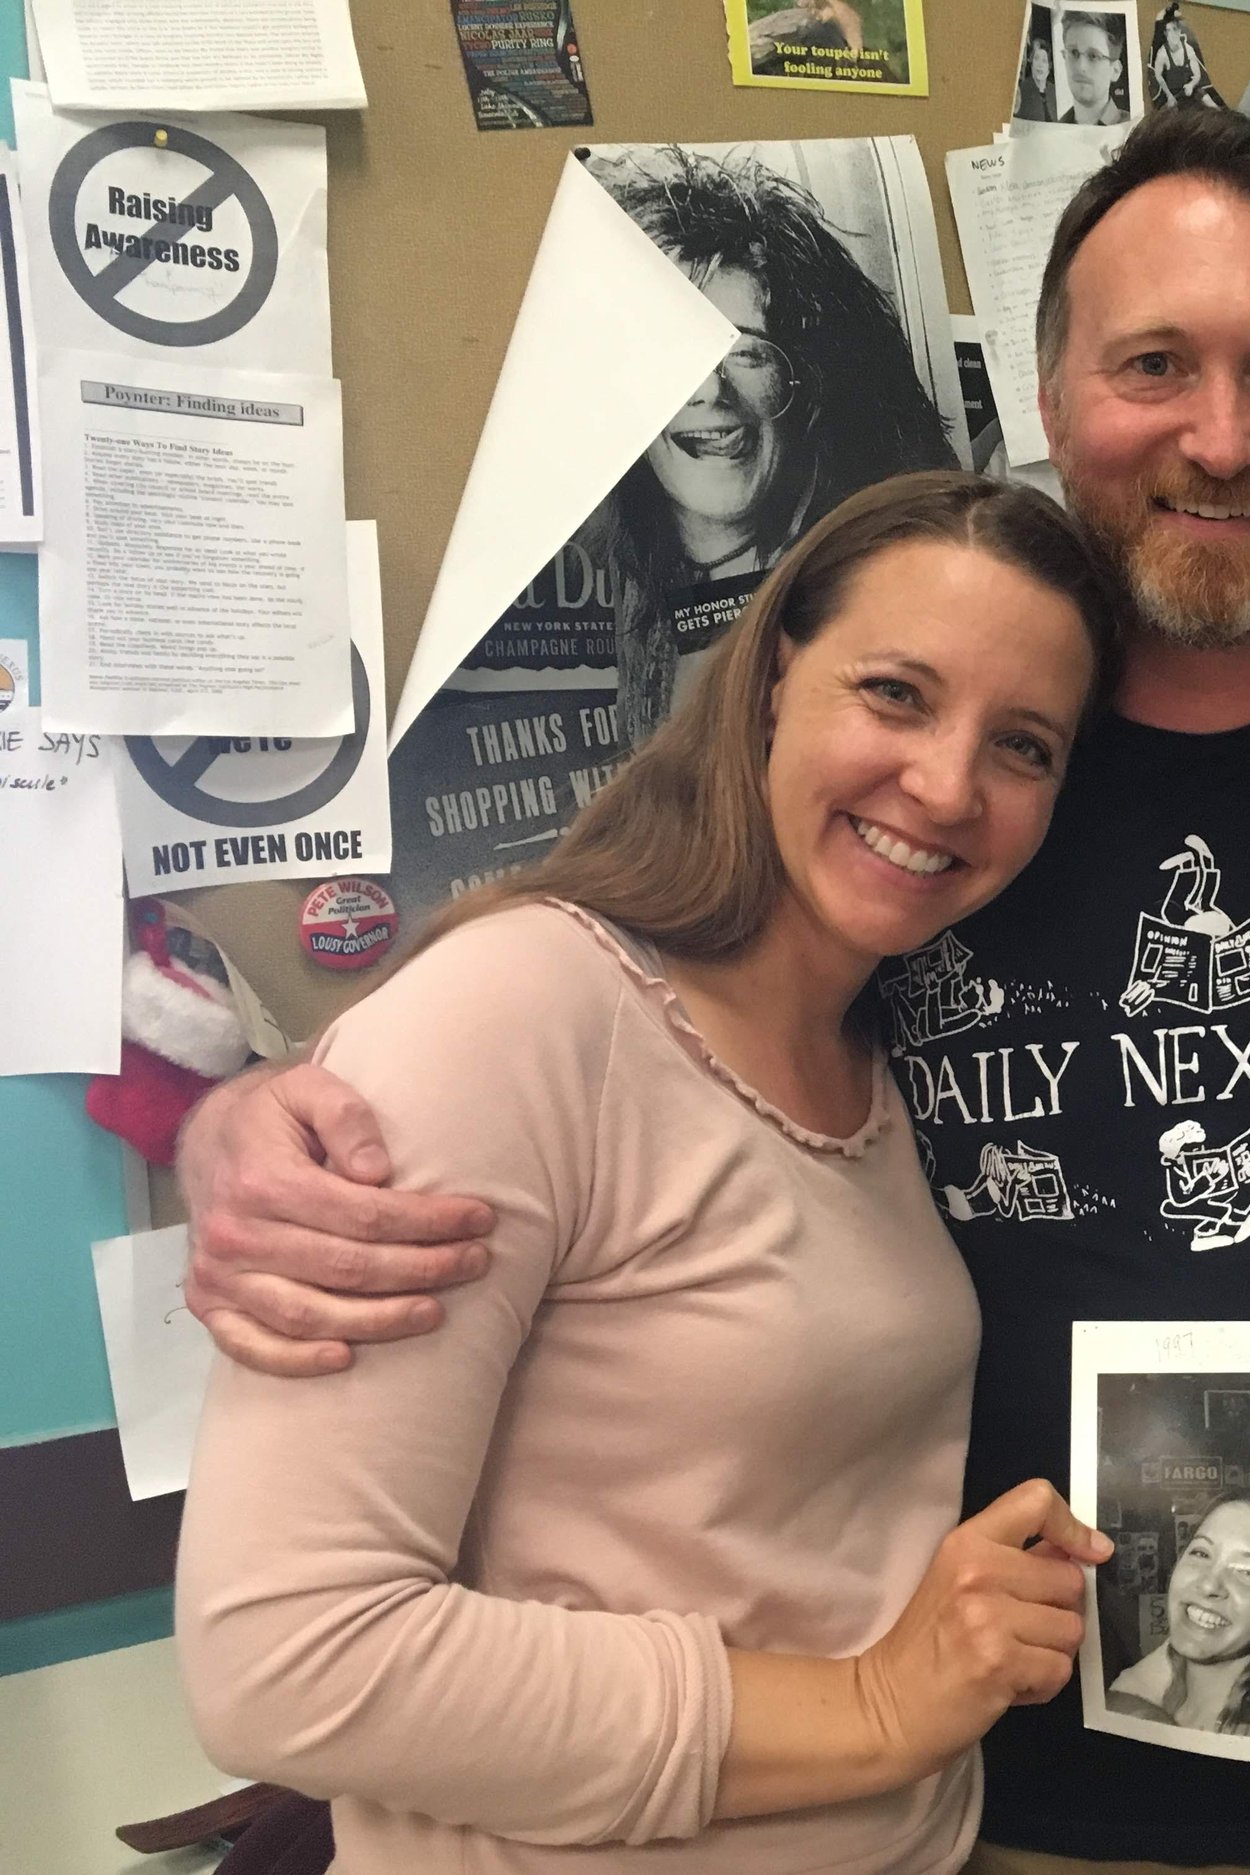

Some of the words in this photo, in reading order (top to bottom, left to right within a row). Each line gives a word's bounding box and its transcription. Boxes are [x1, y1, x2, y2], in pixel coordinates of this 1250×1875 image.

[459, 29, 507, 41] NICOLAS
[508, 29, 534, 40] JAAR
[491, 39, 527, 49] PURITY
[531, 38, 554, 48] RING
[774, 42, 808, 55] Your
[860, 48, 889, 61] isn't
[784, 61, 833, 77] fooling
[835, 66, 882, 79] anyone
[971, 156, 1005, 171] NEWS
[108, 186, 213, 232] Raising
[85, 223, 240, 272] Awareness
[104, 385, 171, 406] Poynter:
[177, 395, 236, 416] Finding
[240, 403, 280, 418] ideas
[85, 434, 131, 447] Twenty-one
[170, 444, 188, 452] Find
[674, 606, 691, 620] MY
[693, 597, 736, 614] HONOR
[504, 621, 533, 631] NEW
[536, 621, 571, 631] YORK
[574, 621, 614, 631] STATE
[676, 615, 710, 633] GETS
[484, 638, 579, 657] CHAMPAGNE
[586, 638, 616, 656] ROU
[38, 731, 101, 765] SAYS
[466, 713, 567, 766] THANKS
[425, 776, 558, 837] SHOPPING
[569, 764, 617, 809] WIT
[152, 840, 207, 876] NOT
[214, 832, 287, 868] EVEN
[294, 830, 363, 862] ONCE
[307, 886, 337, 917] PETE
[337, 881, 390, 909] WILSON
[335, 895, 361, 905] Great
[328, 904, 371, 915] Politician
[312, 936, 342, 953] LOUSY
[343, 926, 390, 954] GOVERNOR
[1146, 930, 1189, 947] OPINION
[904, 1041, 1080, 1124] DAILY
